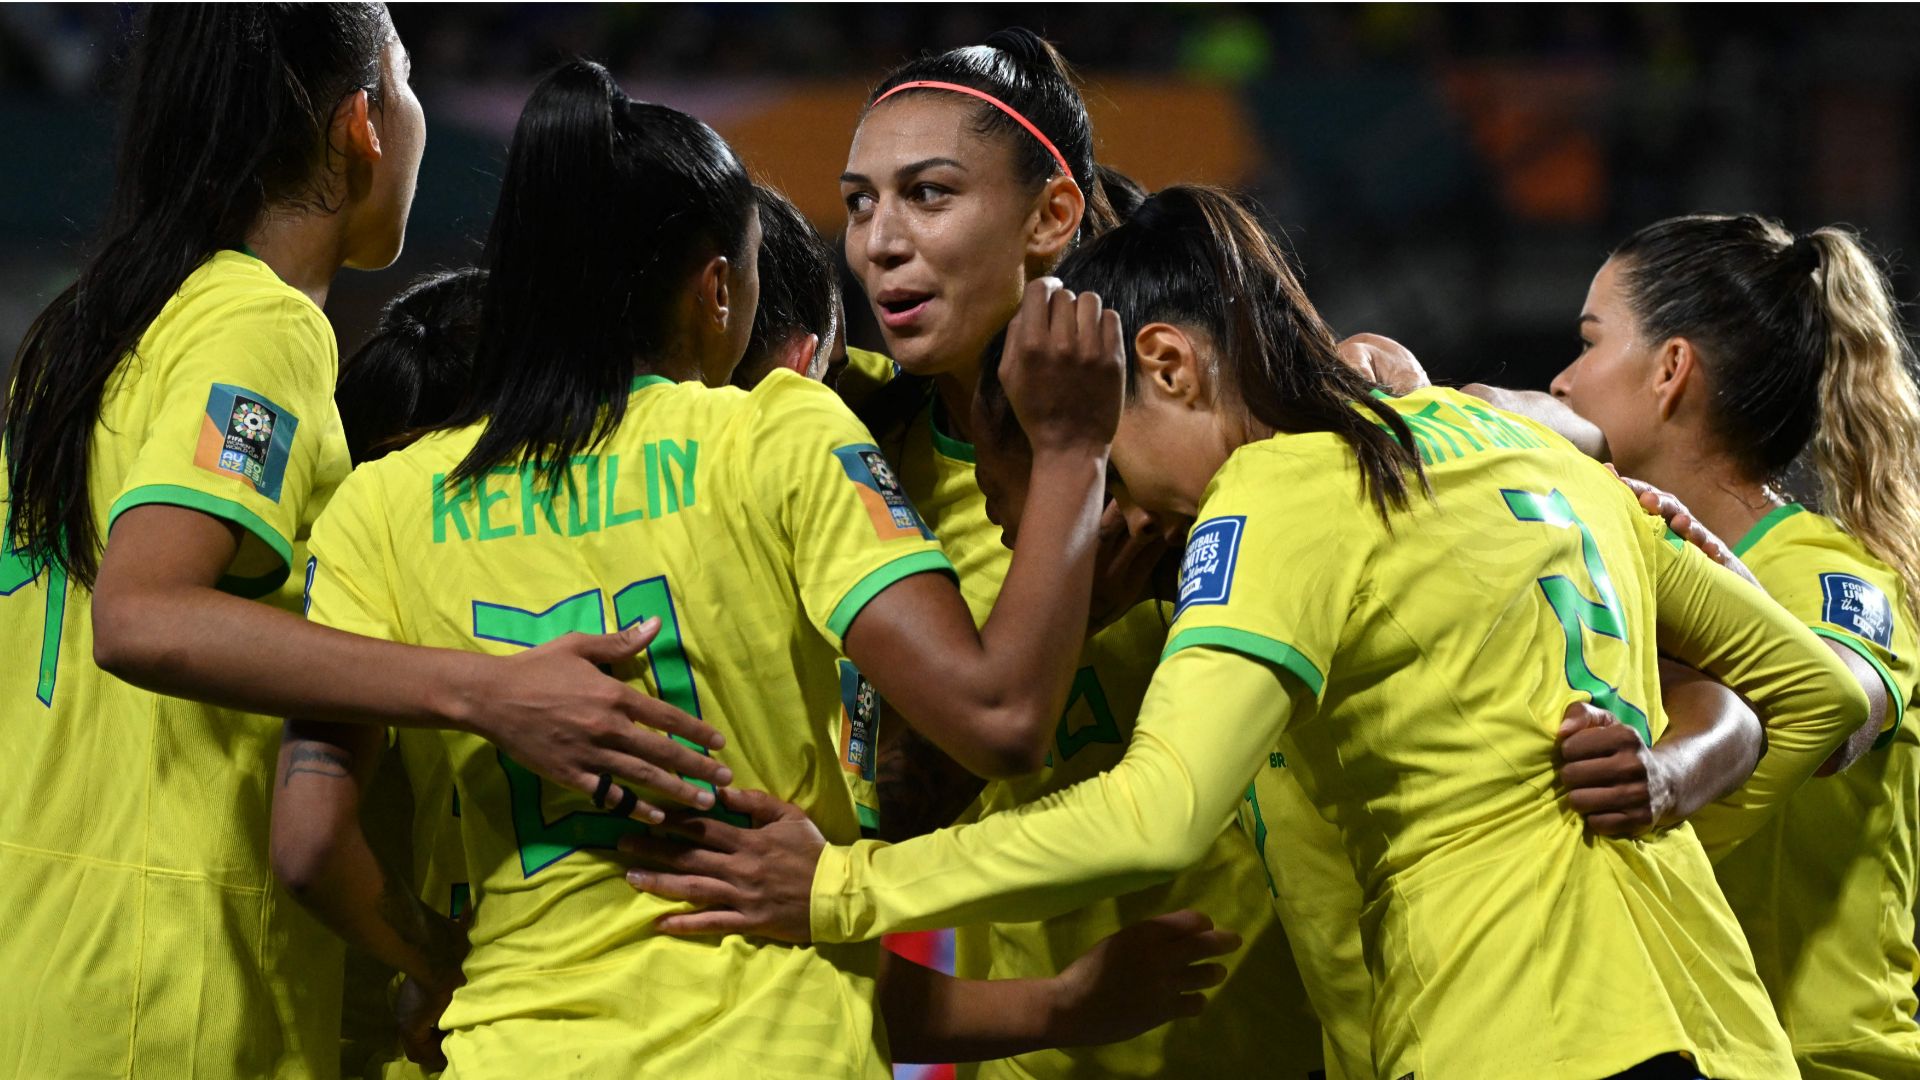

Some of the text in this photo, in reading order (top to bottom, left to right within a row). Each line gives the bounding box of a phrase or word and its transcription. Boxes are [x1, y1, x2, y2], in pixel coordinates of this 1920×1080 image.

[227, 435, 243, 443] FIFA
[223, 451, 244, 463] AU
[221, 459, 241, 471] NZ
[432, 438, 698, 543] KEROLIN
